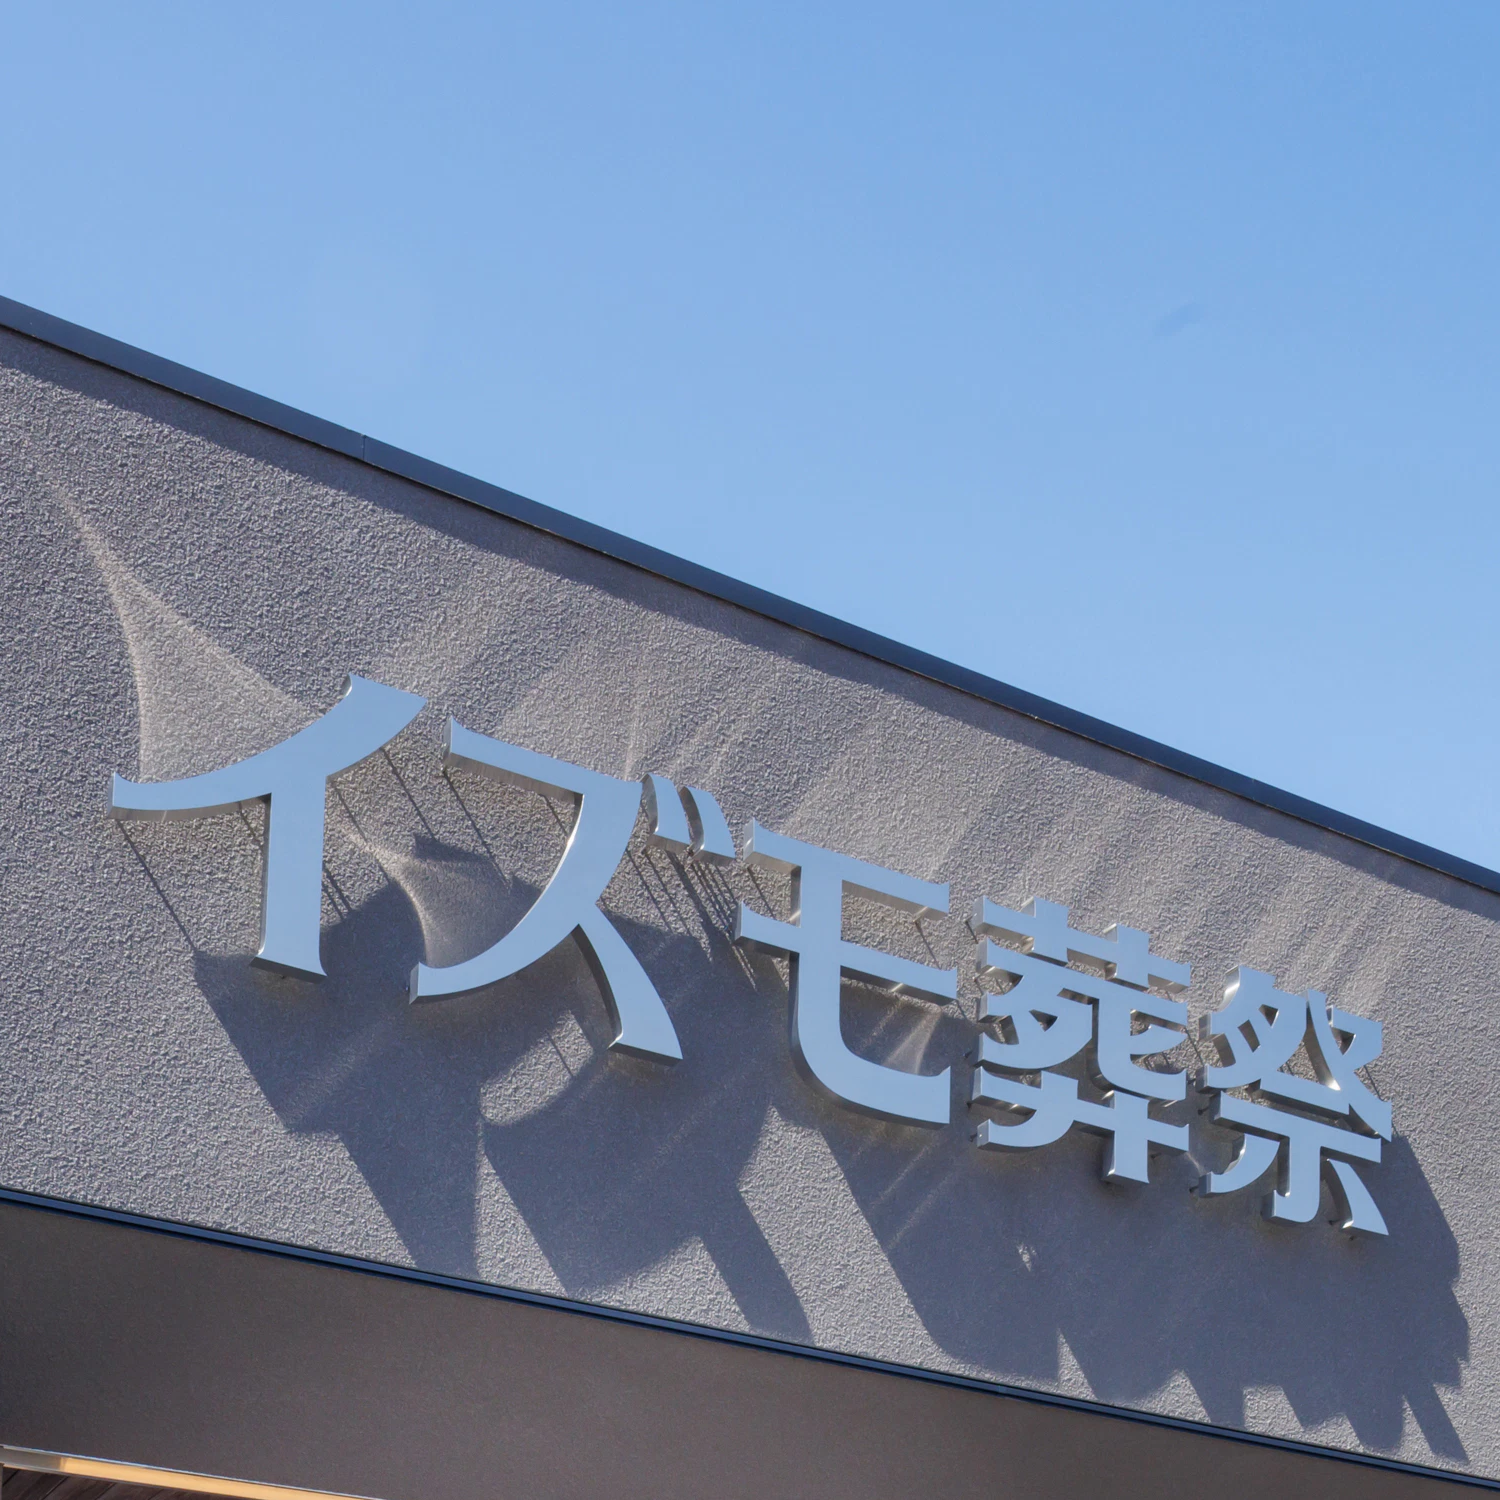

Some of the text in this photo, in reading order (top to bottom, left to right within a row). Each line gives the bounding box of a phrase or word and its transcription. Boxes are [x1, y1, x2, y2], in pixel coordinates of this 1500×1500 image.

[110, 673, 1394, 1236] イズモ葬祭
